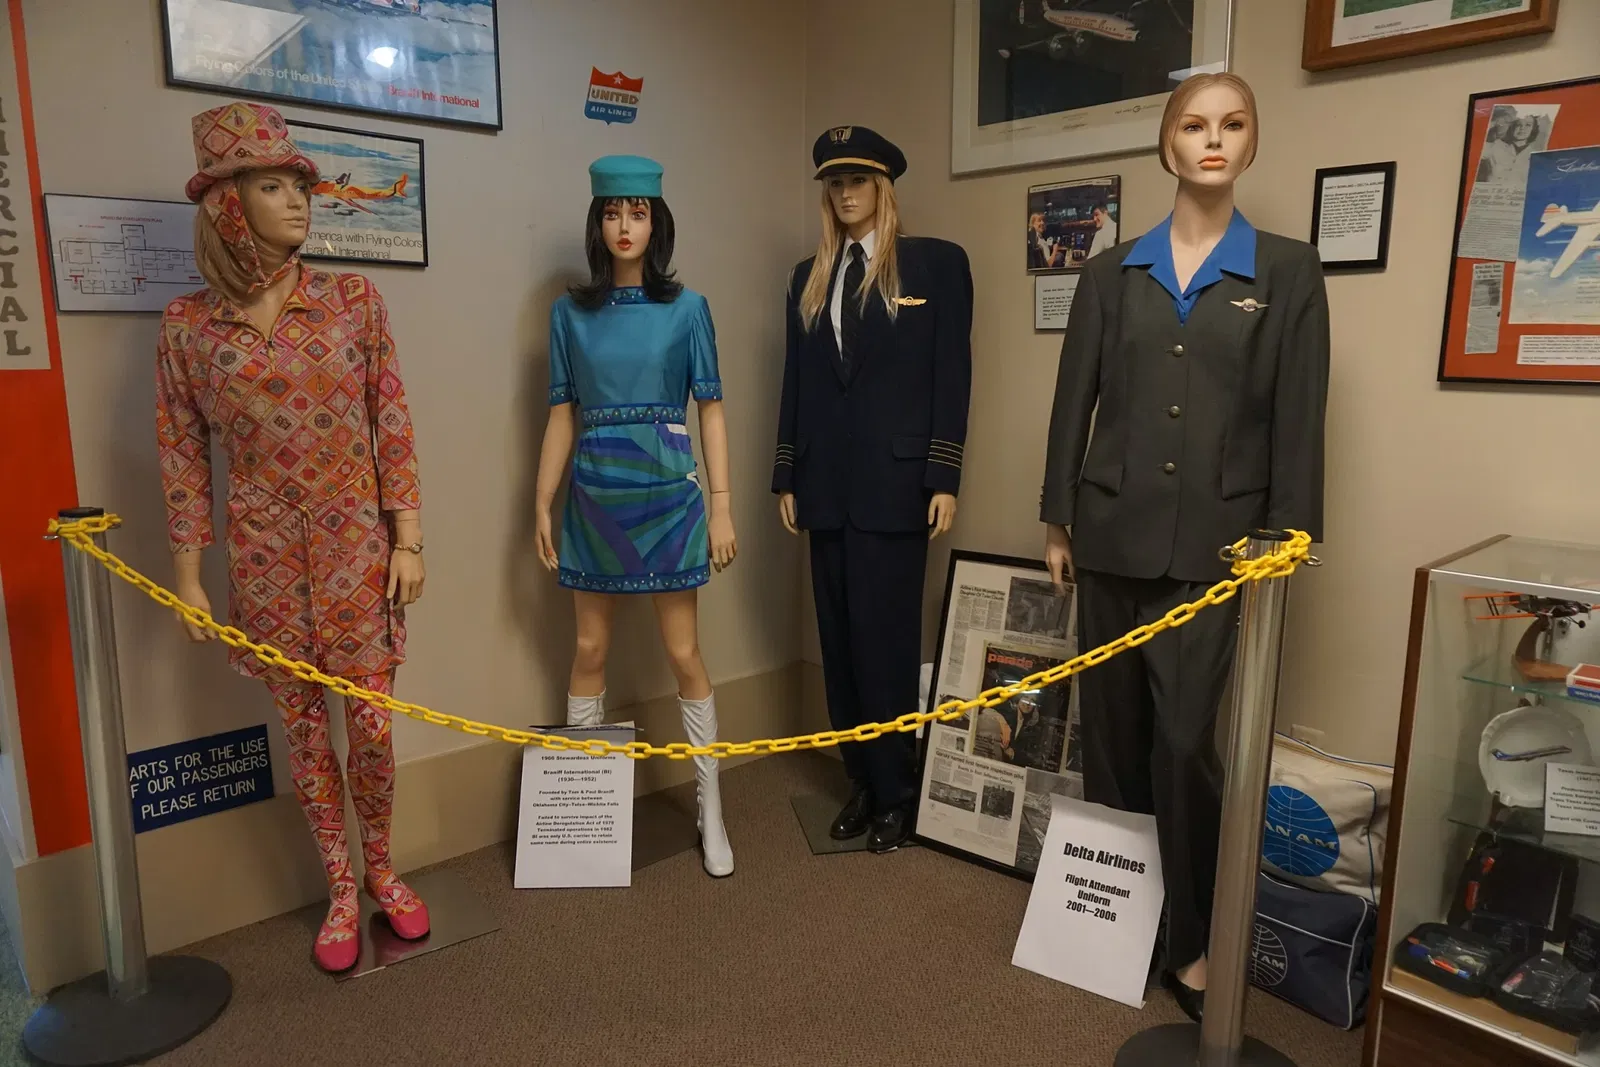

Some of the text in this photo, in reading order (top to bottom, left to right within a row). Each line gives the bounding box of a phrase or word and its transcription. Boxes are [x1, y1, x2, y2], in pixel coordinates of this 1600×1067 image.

[275, 68, 289, 79] of
[290, 70, 310, 82] the
[591, 88, 640, 105] UNITED
[590, 105, 633, 117] AIR LINES
[345, 233, 365, 244] with
[366, 233, 392, 247] Flying
[393, 235, 423, 248] Colors
[339, 246, 391, 259] International
[988, 653, 1034, 670] parade
[130, 737, 267, 782] ARTS FOR THE USE
[147, 776, 176, 794] OUR
[182, 753, 268, 786] PASSENGERS
[141, 778, 256, 820] PLEASE RETURN
[579, 813, 598, 821] impact
[1295, 833, 1337, 850] AM
[1063, 842, 1146, 874] Delta Airlines
[1065, 873, 1131, 899] Flight Attendant
[1077, 889, 1111, 907] Uniform
